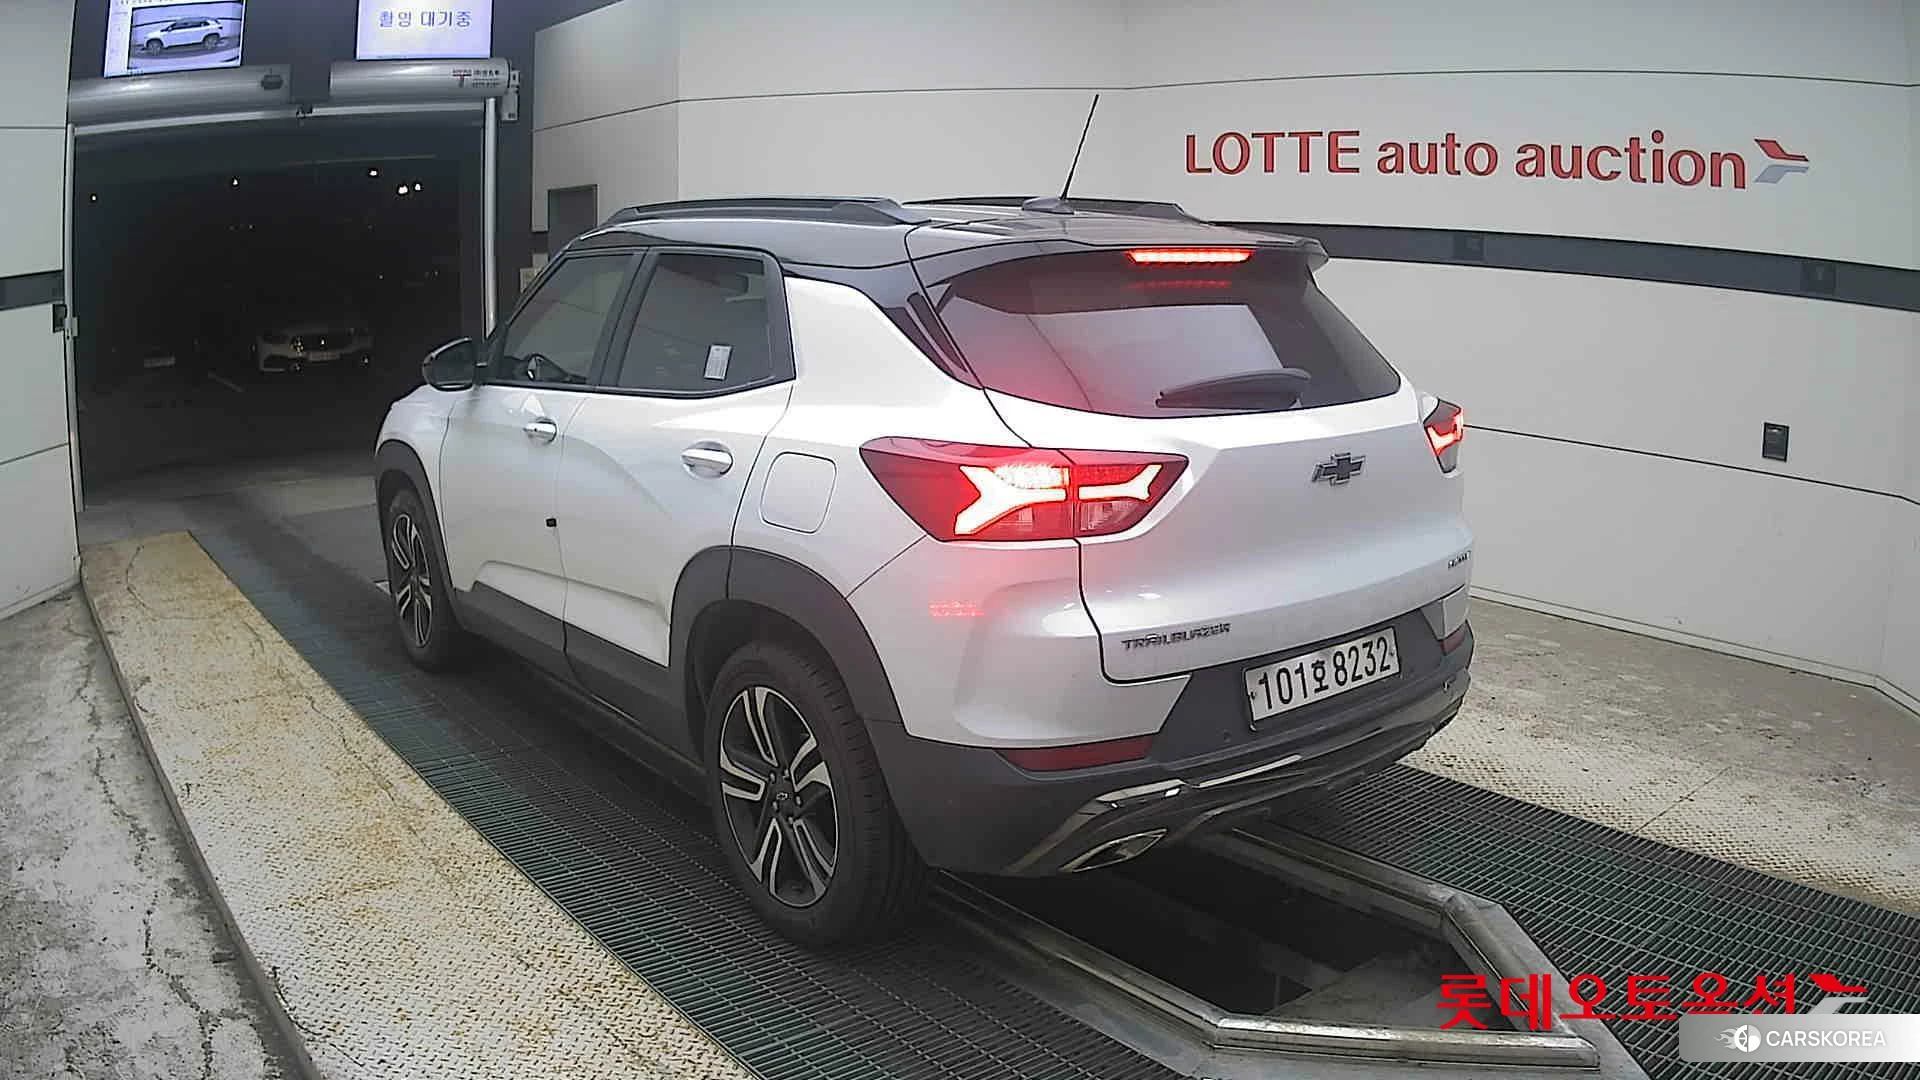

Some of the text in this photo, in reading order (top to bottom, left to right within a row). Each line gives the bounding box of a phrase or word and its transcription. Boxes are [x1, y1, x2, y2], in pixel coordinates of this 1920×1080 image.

[420, 10, 471, 27] 대기중
[1187, 130, 1747, 189] LOTTE auto auction
